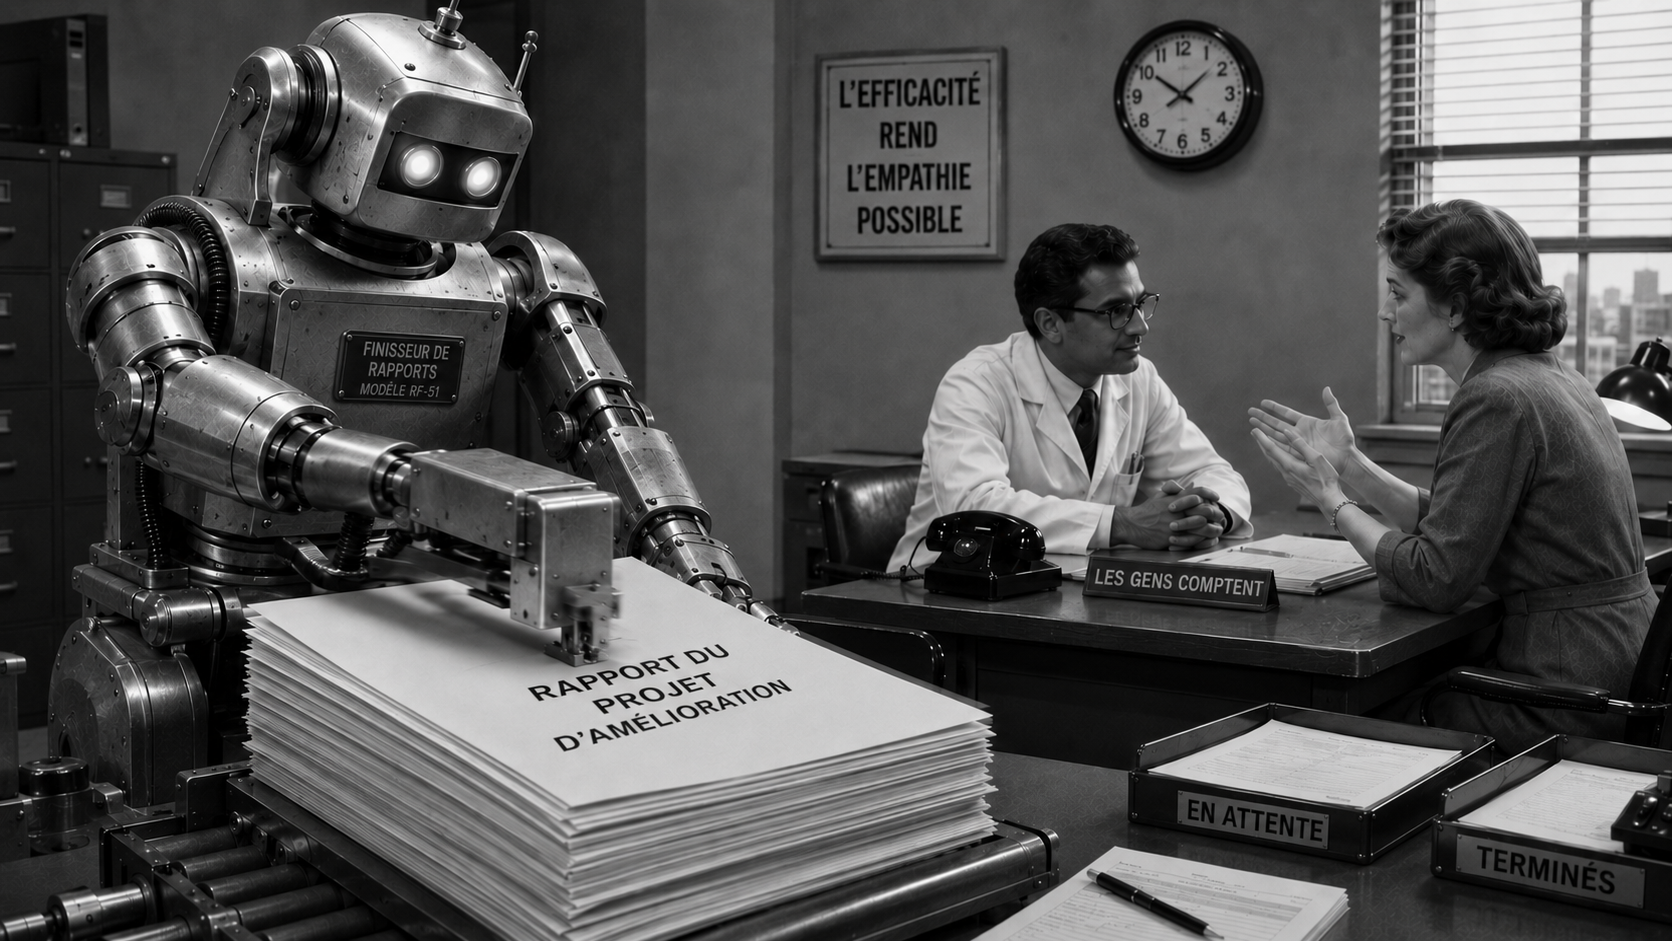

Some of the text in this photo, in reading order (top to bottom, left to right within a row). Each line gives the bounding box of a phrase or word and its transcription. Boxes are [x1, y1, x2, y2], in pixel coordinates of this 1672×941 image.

[1155, 47, 1166, 63] 11
[1175, 40, 1191, 57] 12
[1204, 44, 1209, 61] 1
[1139, 64, 1154, 81] 10
[1216, 61, 1228, 78] 2
[839, 71, 981, 108] L’EFFICACITÉ
[1131, 88, 1143, 105] 9
[1224, 85, 1235, 102] 3
[1138, 112, 1150, 128] 8
[1216, 110, 1228, 126] 4
[879, 121, 938, 149] REND
[1156, 128, 1167, 144] 7
[1177, 133, 1188, 150] 6
[1200, 127, 1212, 144] 5
[847, 162, 972, 192] L’EMPATHIE
[857, 205, 963, 234] POSSIBLE
[363, 341, 450, 360] FINISSEUR DE
[368, 361, 437, 379] RAPPORTS
[409, 385, 440, 398] RF-51
[1094, 568, 1264, 597] LES GENS COMPTENT
[527, 644, 730, 702] RAPPORT DU
[592, 672, 717, 715] PROJET
[553, 679, 792, 752] D’AMÉLIORATION
[1187, 799, 1324, 843] EN ATTENTE
[1476, 844, 1616, 895] TERMINÉS
